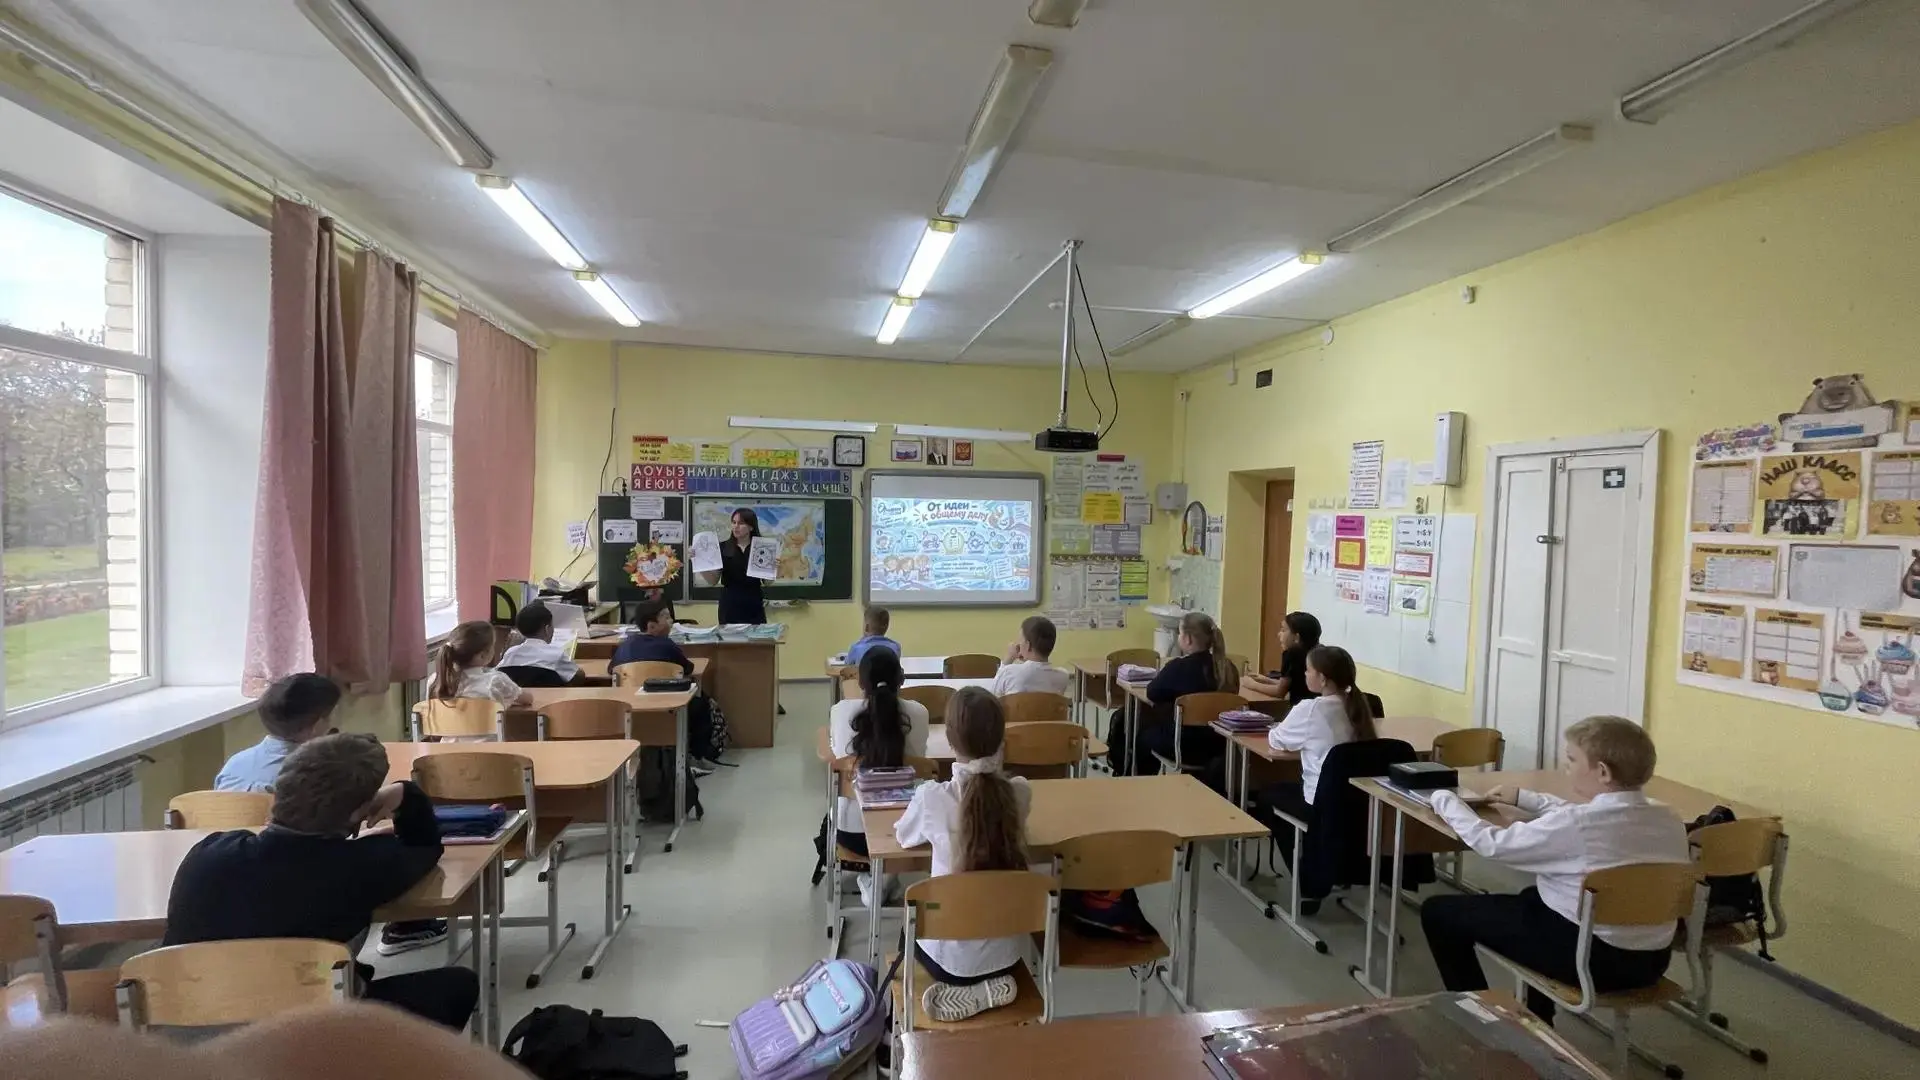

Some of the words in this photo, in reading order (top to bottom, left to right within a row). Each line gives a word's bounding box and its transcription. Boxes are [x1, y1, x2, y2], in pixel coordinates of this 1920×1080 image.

[1761, 457, 1798, 486] НАШ
[1802, 455, 1857, 482] КЛАСС
[927, 501, 942, 512] От
[944, 502, 970, 511] идеи
[930, 510, 966, 520] общему
[967, 511, 989, 523] делу
